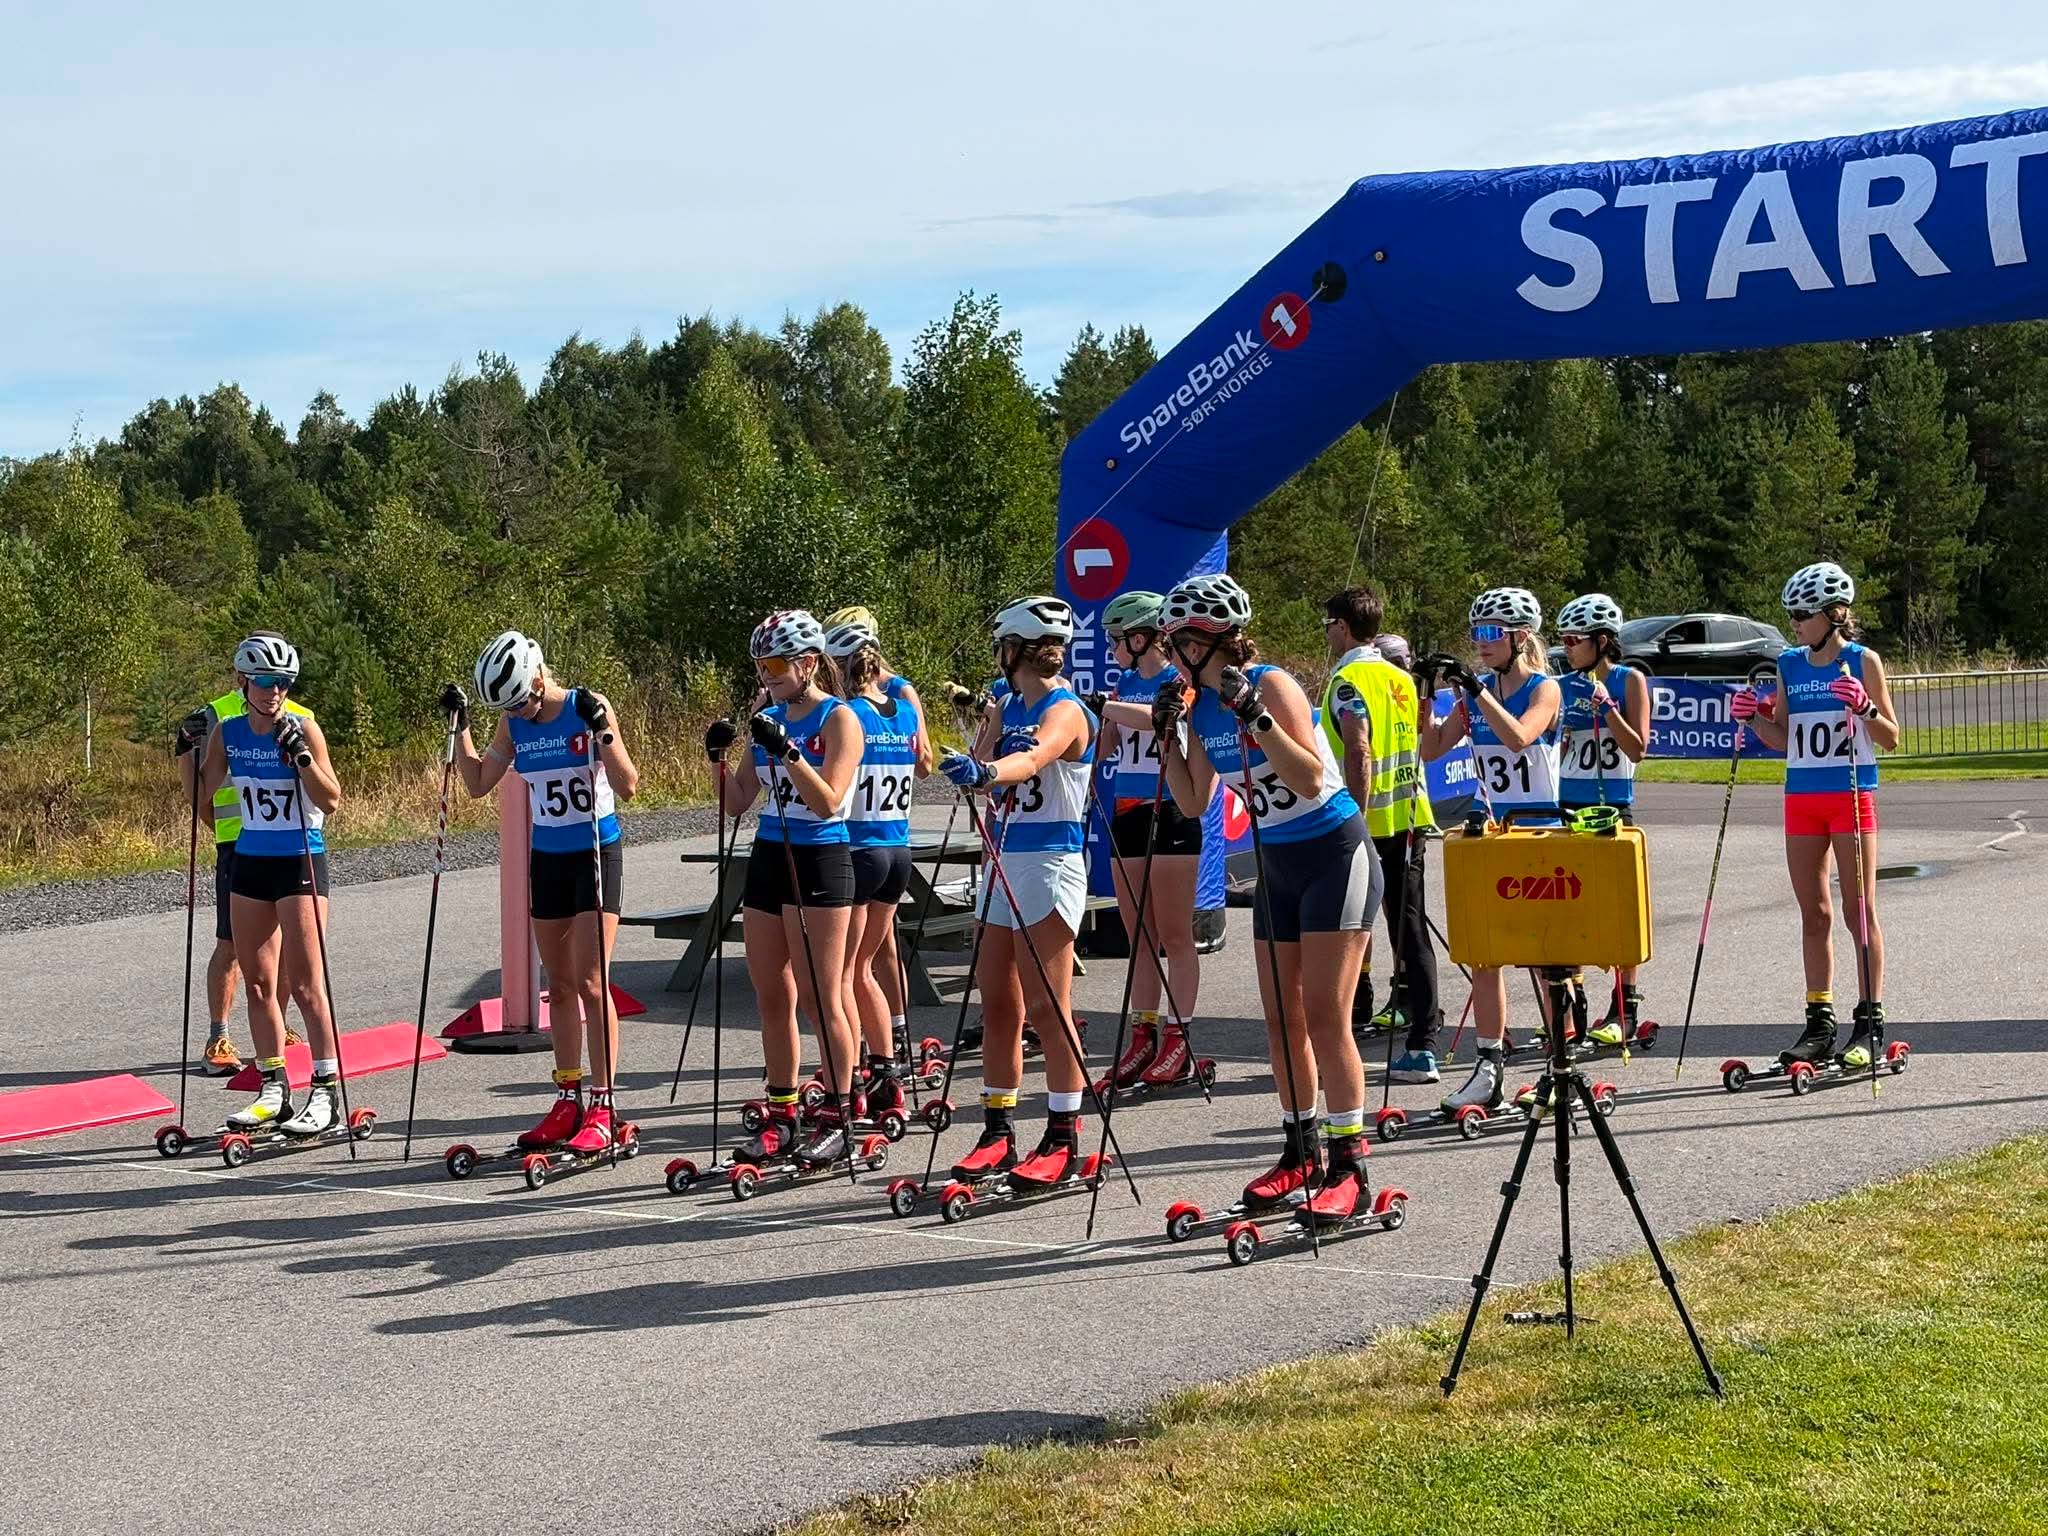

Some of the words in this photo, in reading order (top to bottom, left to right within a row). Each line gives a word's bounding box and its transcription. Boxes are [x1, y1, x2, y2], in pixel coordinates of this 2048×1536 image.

[1516, 130, 2048, 312] START
[1120, 329, 1261, 453] SpareBank
[1271, 303, 1297, 337] 1
[1182, 352, 1273, 433] SØR-NORGE
[1074, 549, 1113, 576] 1
[1795, 721, 1858, 759] 102
[242, 786, 295, 822] 157
[858, 775, 912, 812] 128
[1496, 866, 1583, 900] emit
[1151, 1040, 1186, 1077] alpina
